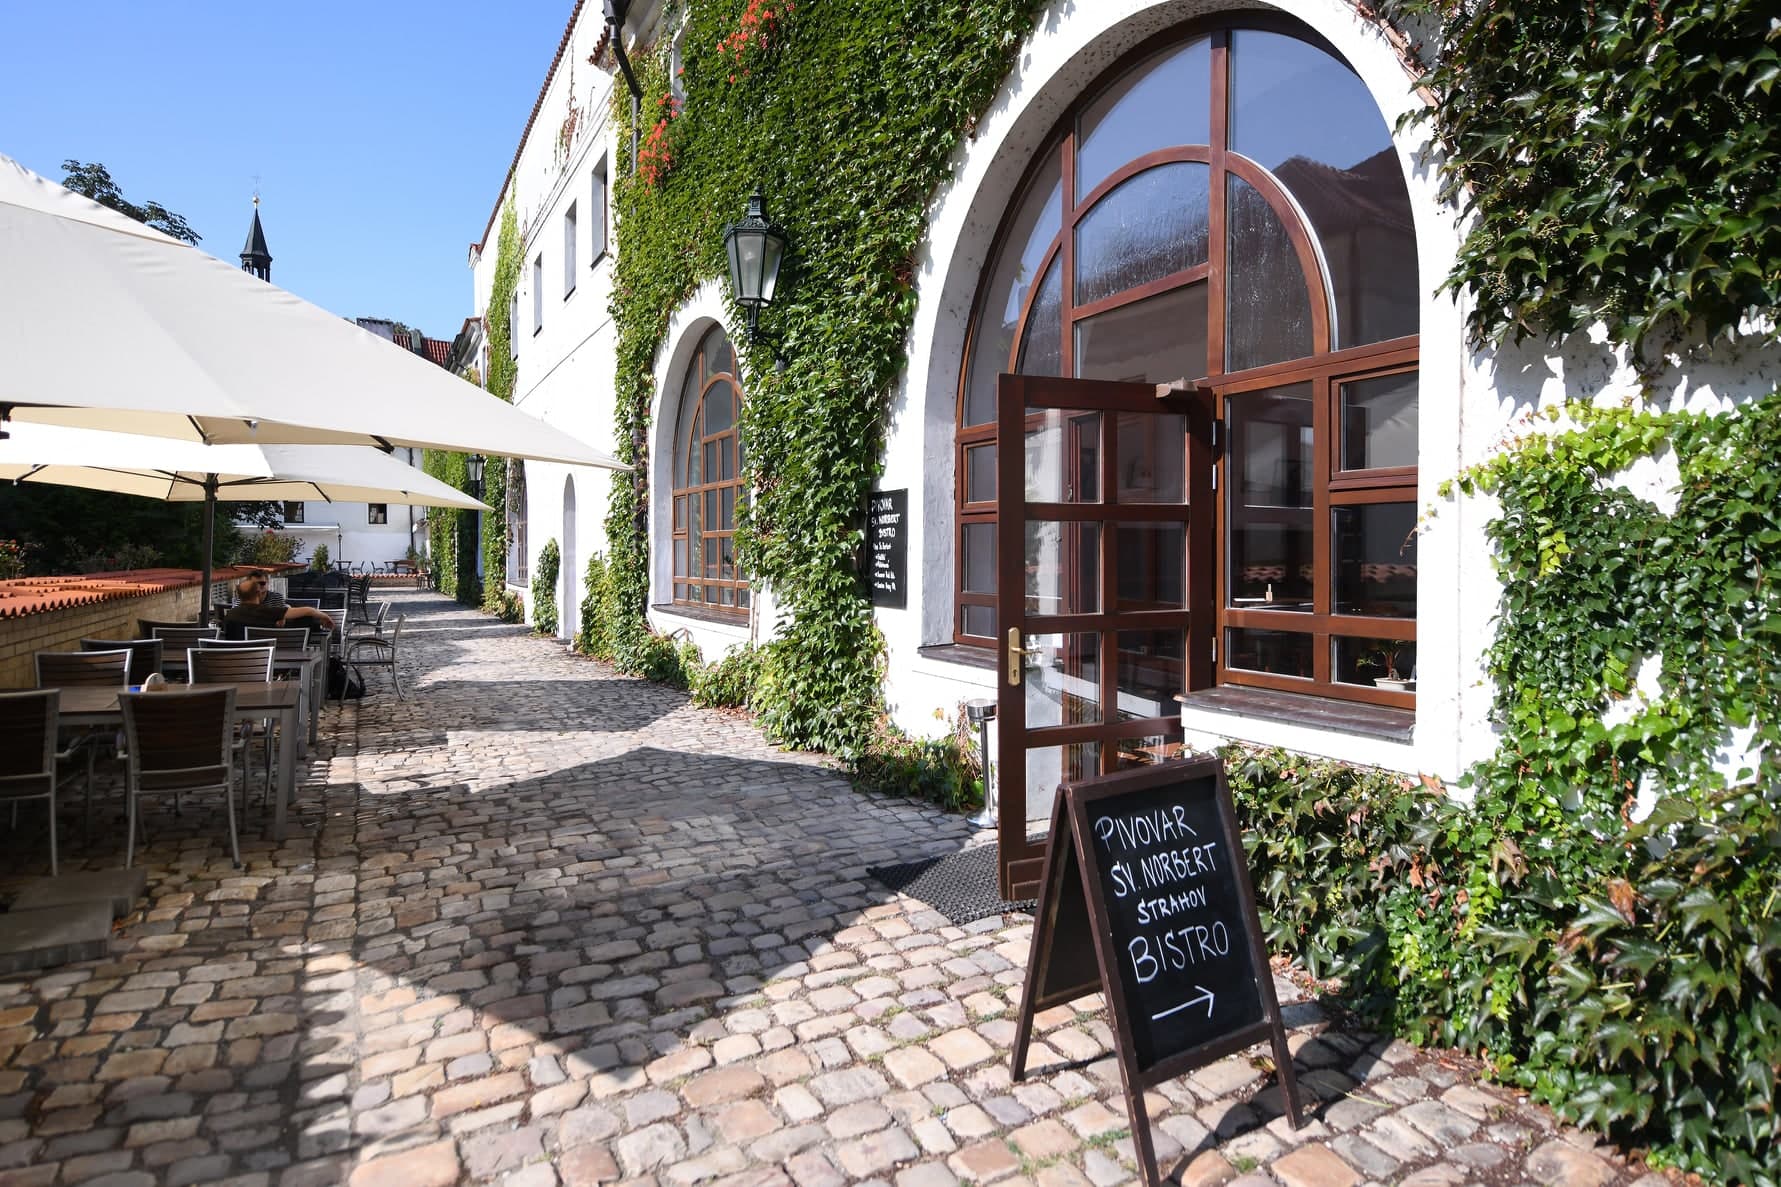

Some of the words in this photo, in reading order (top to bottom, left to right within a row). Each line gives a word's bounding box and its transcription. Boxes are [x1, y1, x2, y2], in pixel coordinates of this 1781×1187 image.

[878, 527, 896, 538] BISTRO
[1095, 805, 1197, 852] PIVOVAR
[1110, 860, 1142, 898] SV.
[1141, 842, 1217, 889] NORBERT
[1137, 884, 1207, 924] STRAHOV
[1128, 920, 1229, 984] BISTRO
